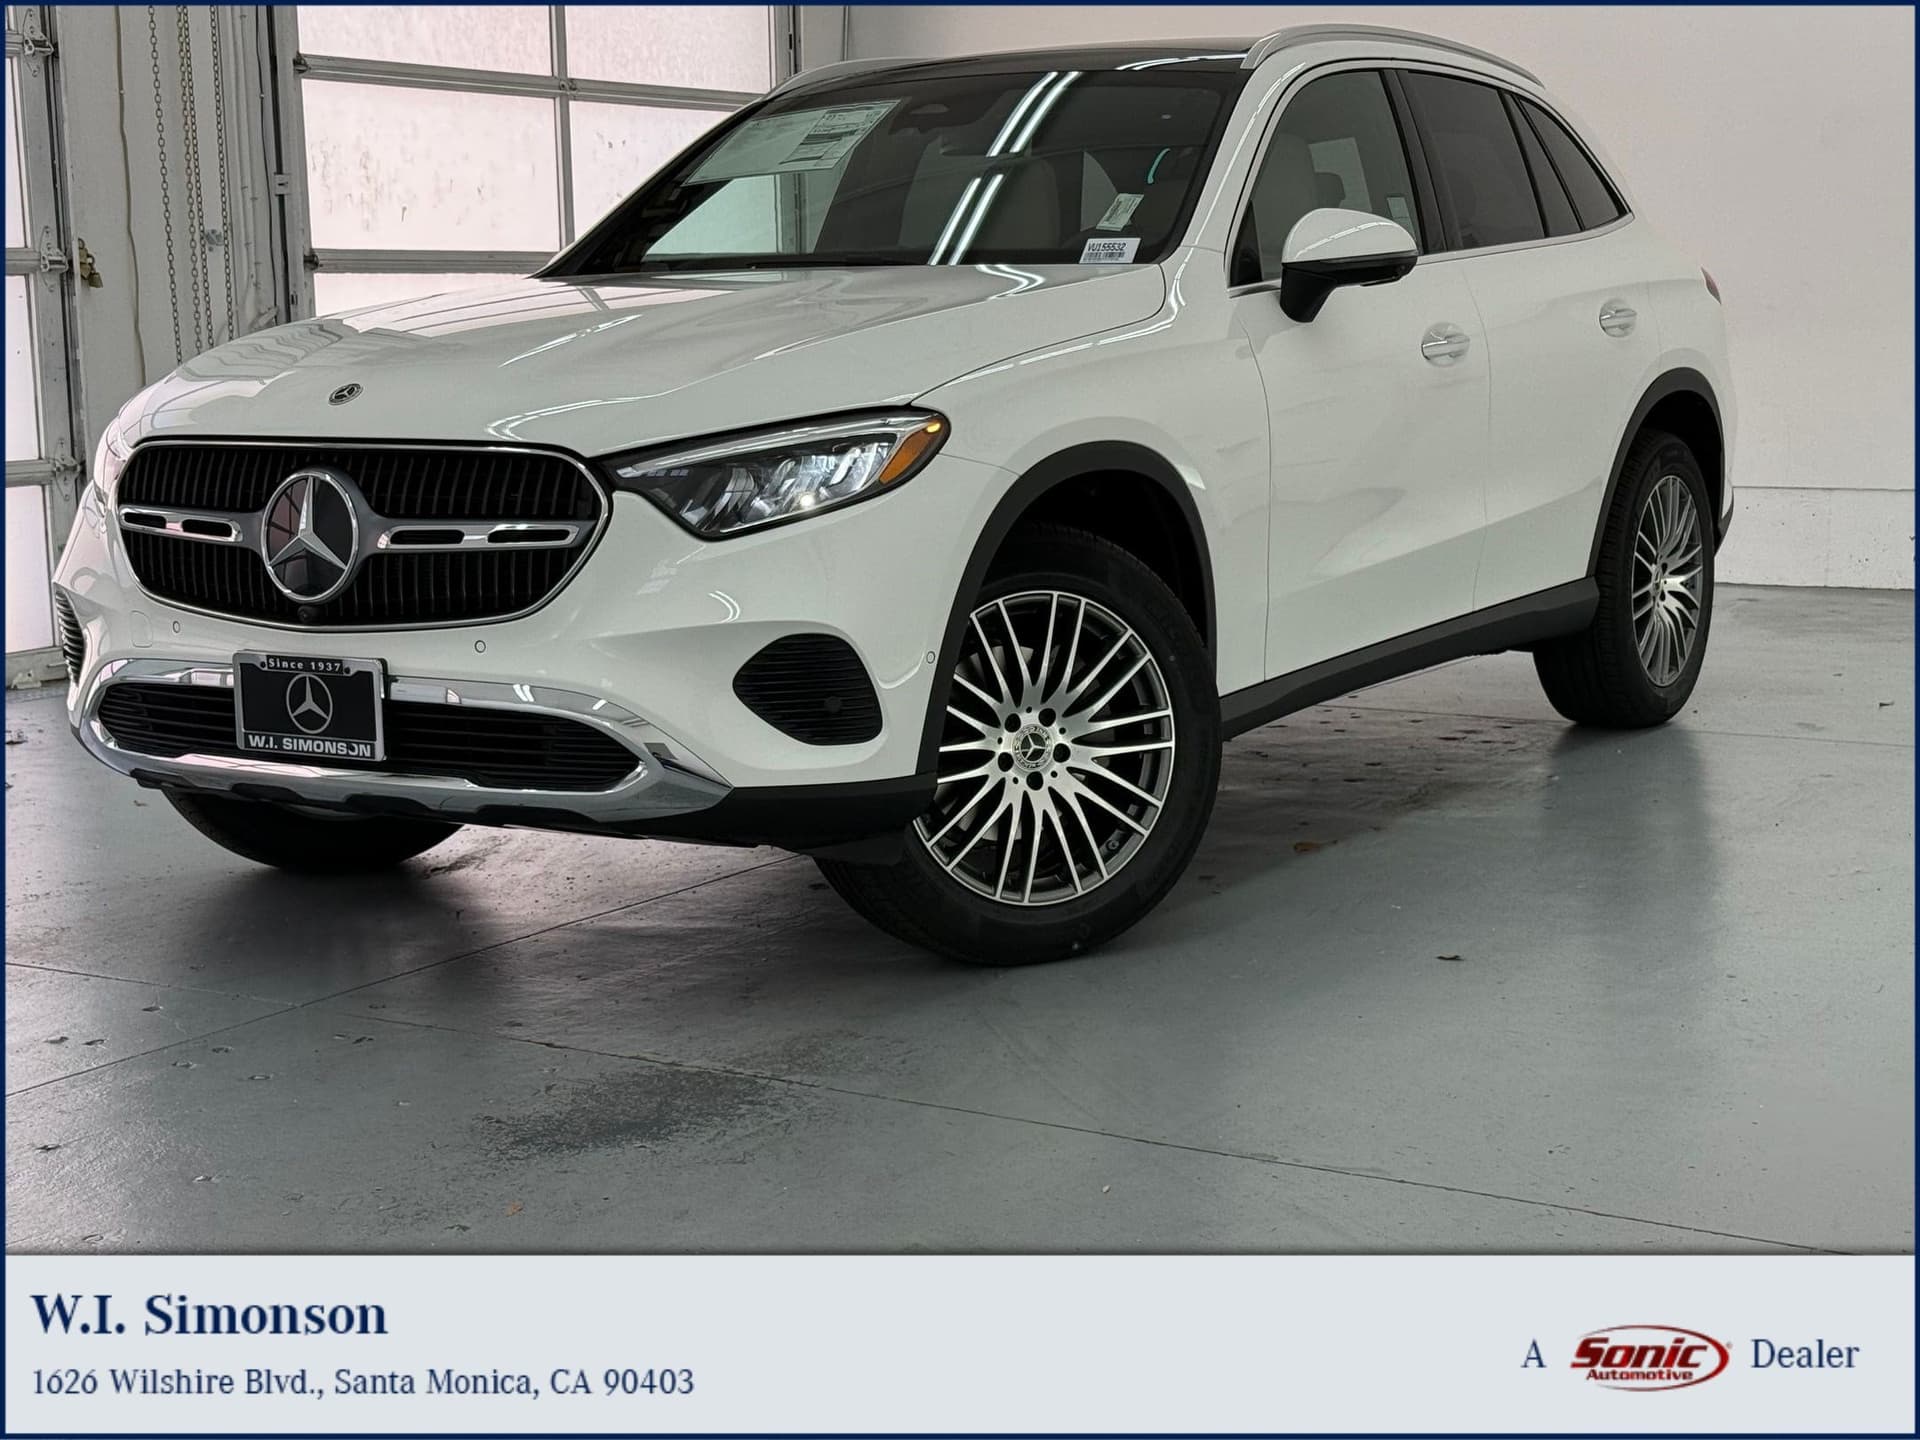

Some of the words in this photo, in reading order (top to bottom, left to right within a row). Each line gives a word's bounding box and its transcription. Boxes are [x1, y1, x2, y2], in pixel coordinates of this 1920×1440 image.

[268, 658, 304, 669] Since
[310, 661, 341, 672] 1937
[248, 734, 278, 749] W.I.
